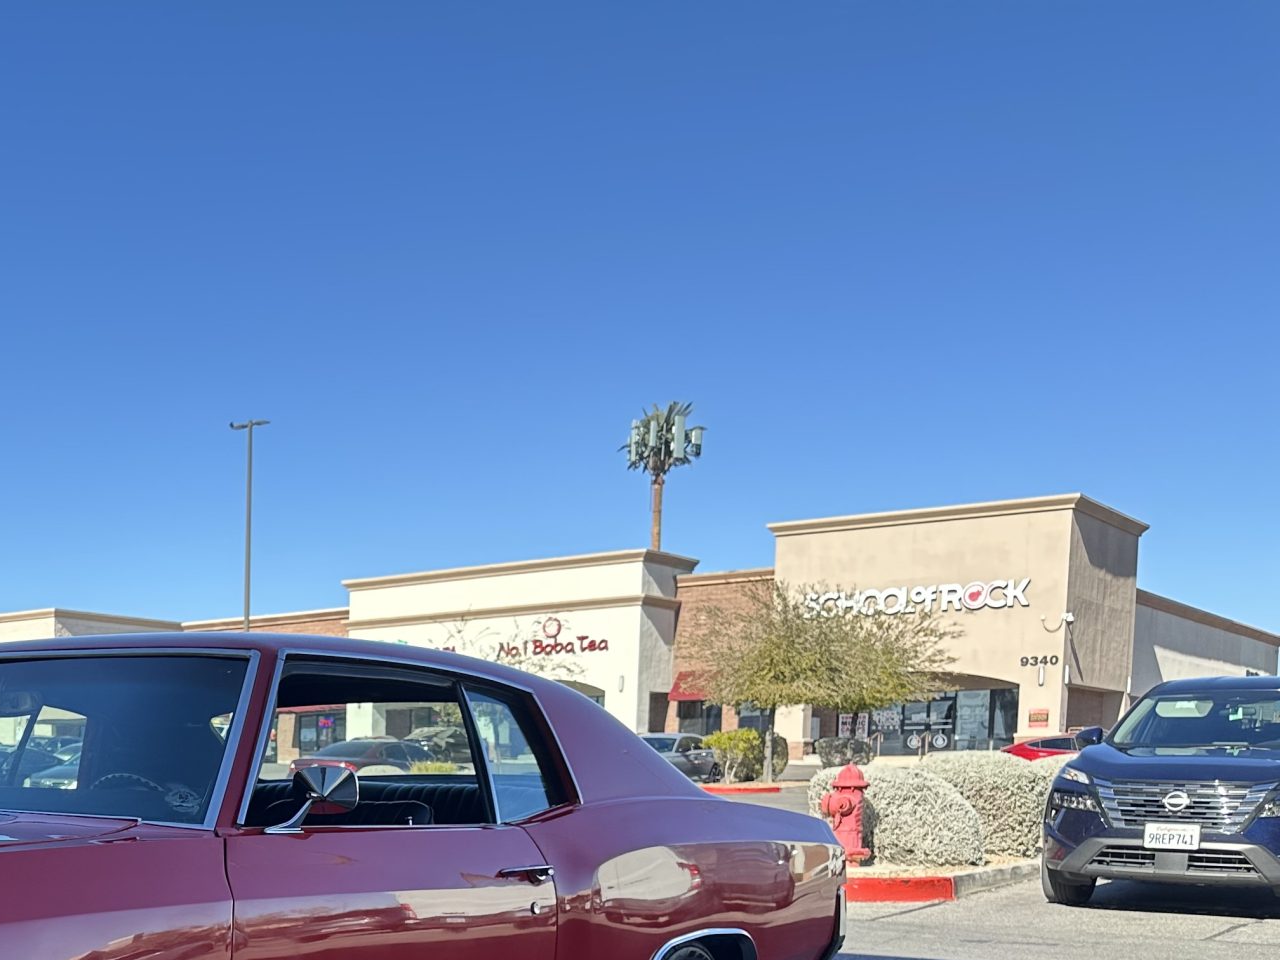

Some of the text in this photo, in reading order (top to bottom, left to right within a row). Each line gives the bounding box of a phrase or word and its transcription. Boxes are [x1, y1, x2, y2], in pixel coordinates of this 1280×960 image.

[939, 577, 1032, 613] ROCK
[532, 637, 576, 657] Boba
[576, 635, 609, 653] Tea
[1020, 655, 1059, 667] 9340
[1148, 833, 1195, 846] 9REP741
